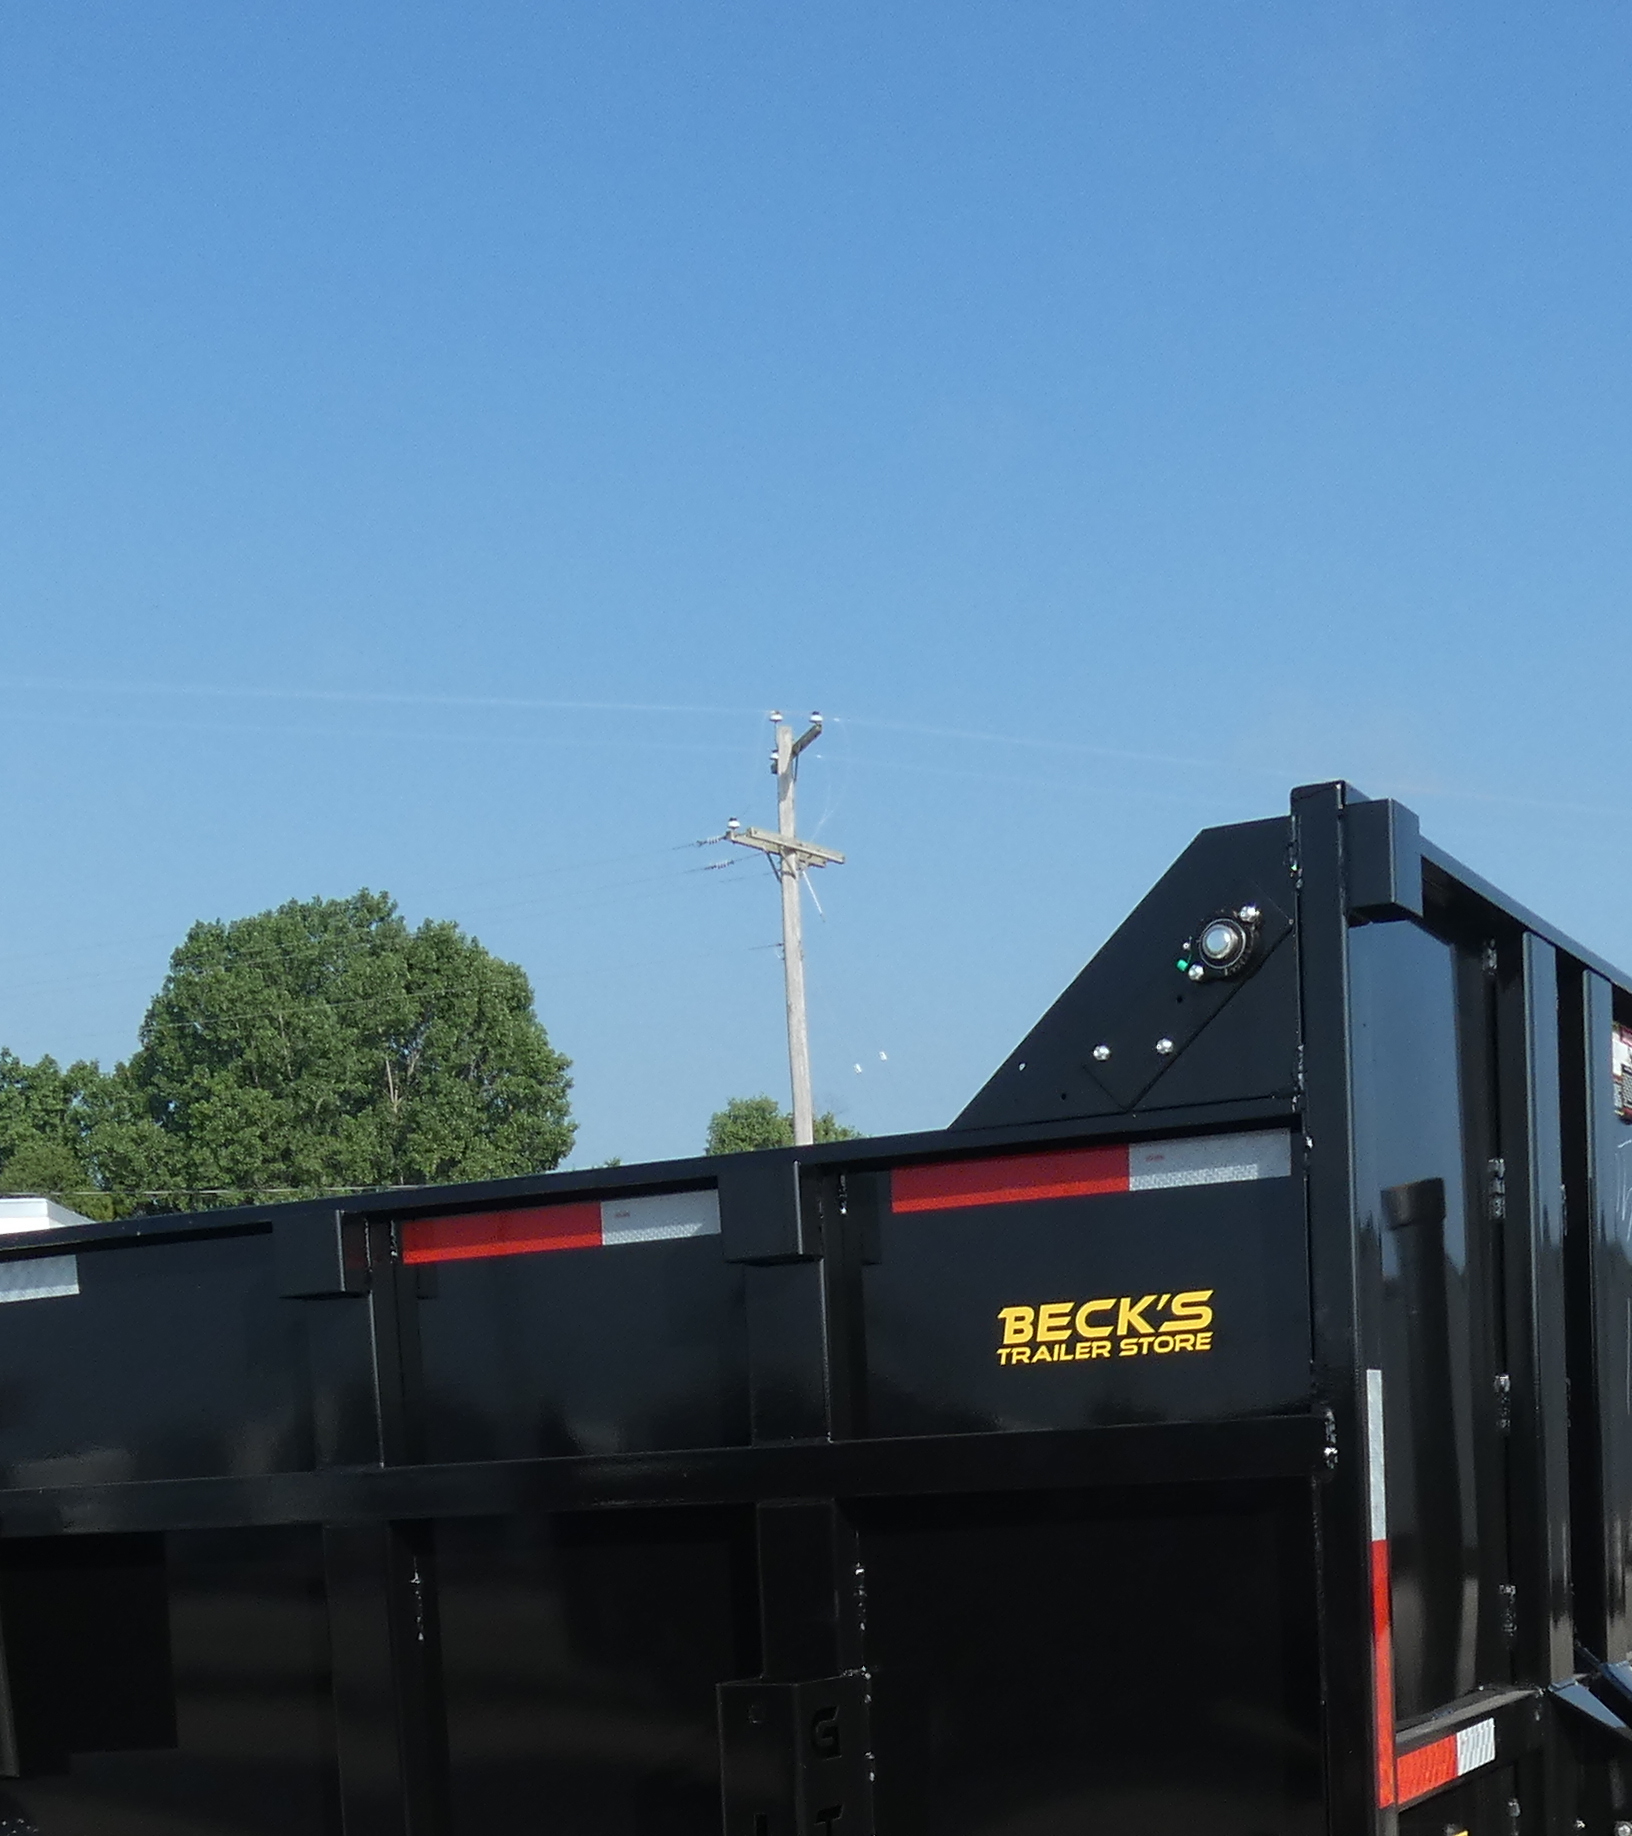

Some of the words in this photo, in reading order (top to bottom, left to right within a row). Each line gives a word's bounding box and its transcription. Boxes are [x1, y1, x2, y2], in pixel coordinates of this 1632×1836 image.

[996, 1288, 1215, 1345] BECK'S
[996, 1340, 1112, 1366] TRAILER
[1118, 1331, 1215, 1357] STORE
